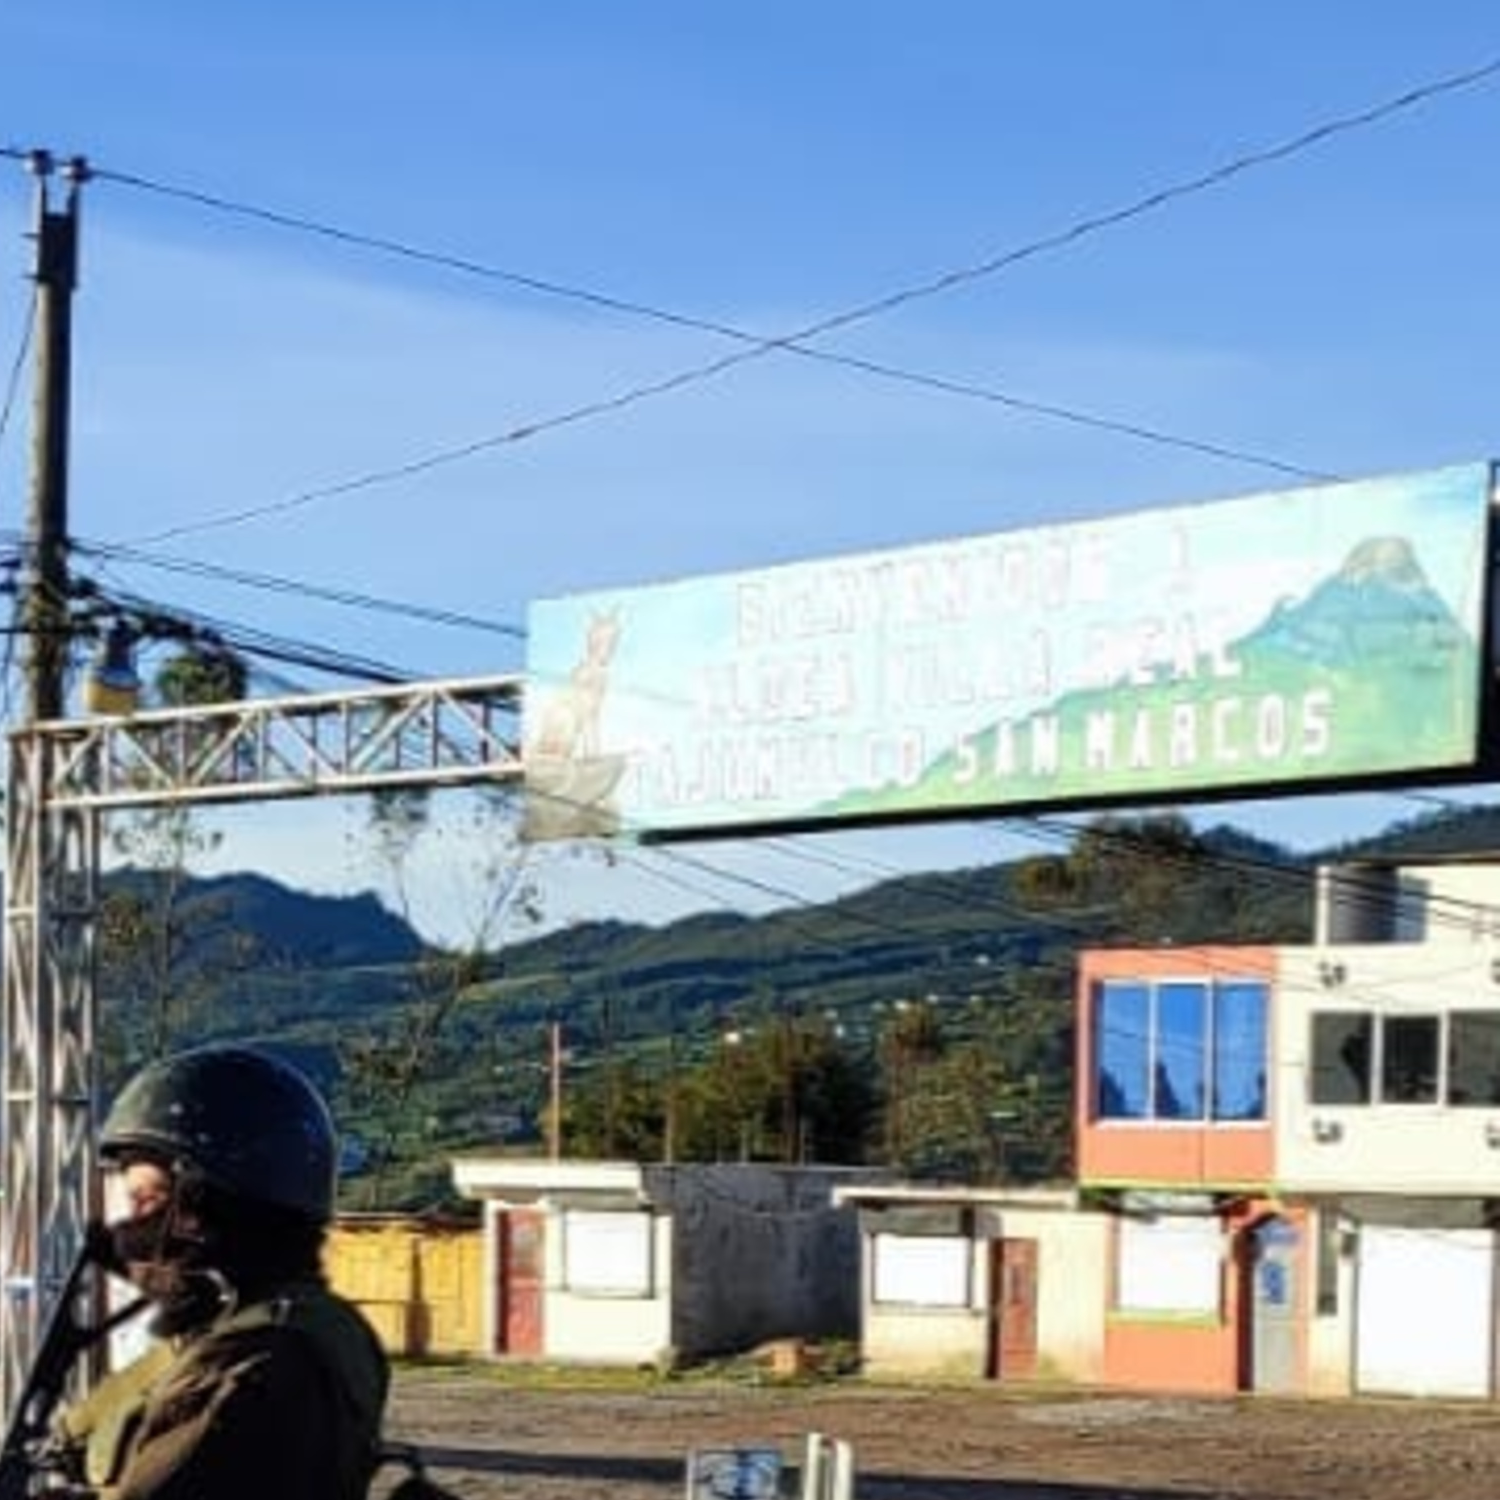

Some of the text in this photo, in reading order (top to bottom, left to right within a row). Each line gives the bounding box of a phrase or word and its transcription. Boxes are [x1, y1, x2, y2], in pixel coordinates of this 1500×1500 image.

[736, 534, 1109, 648] BIENVENIDO
[1092, 606, 1242, 686] EAL
[953, 712, 1060, 783] SAN
[1085, 692, 1334, 770] MARCOS
